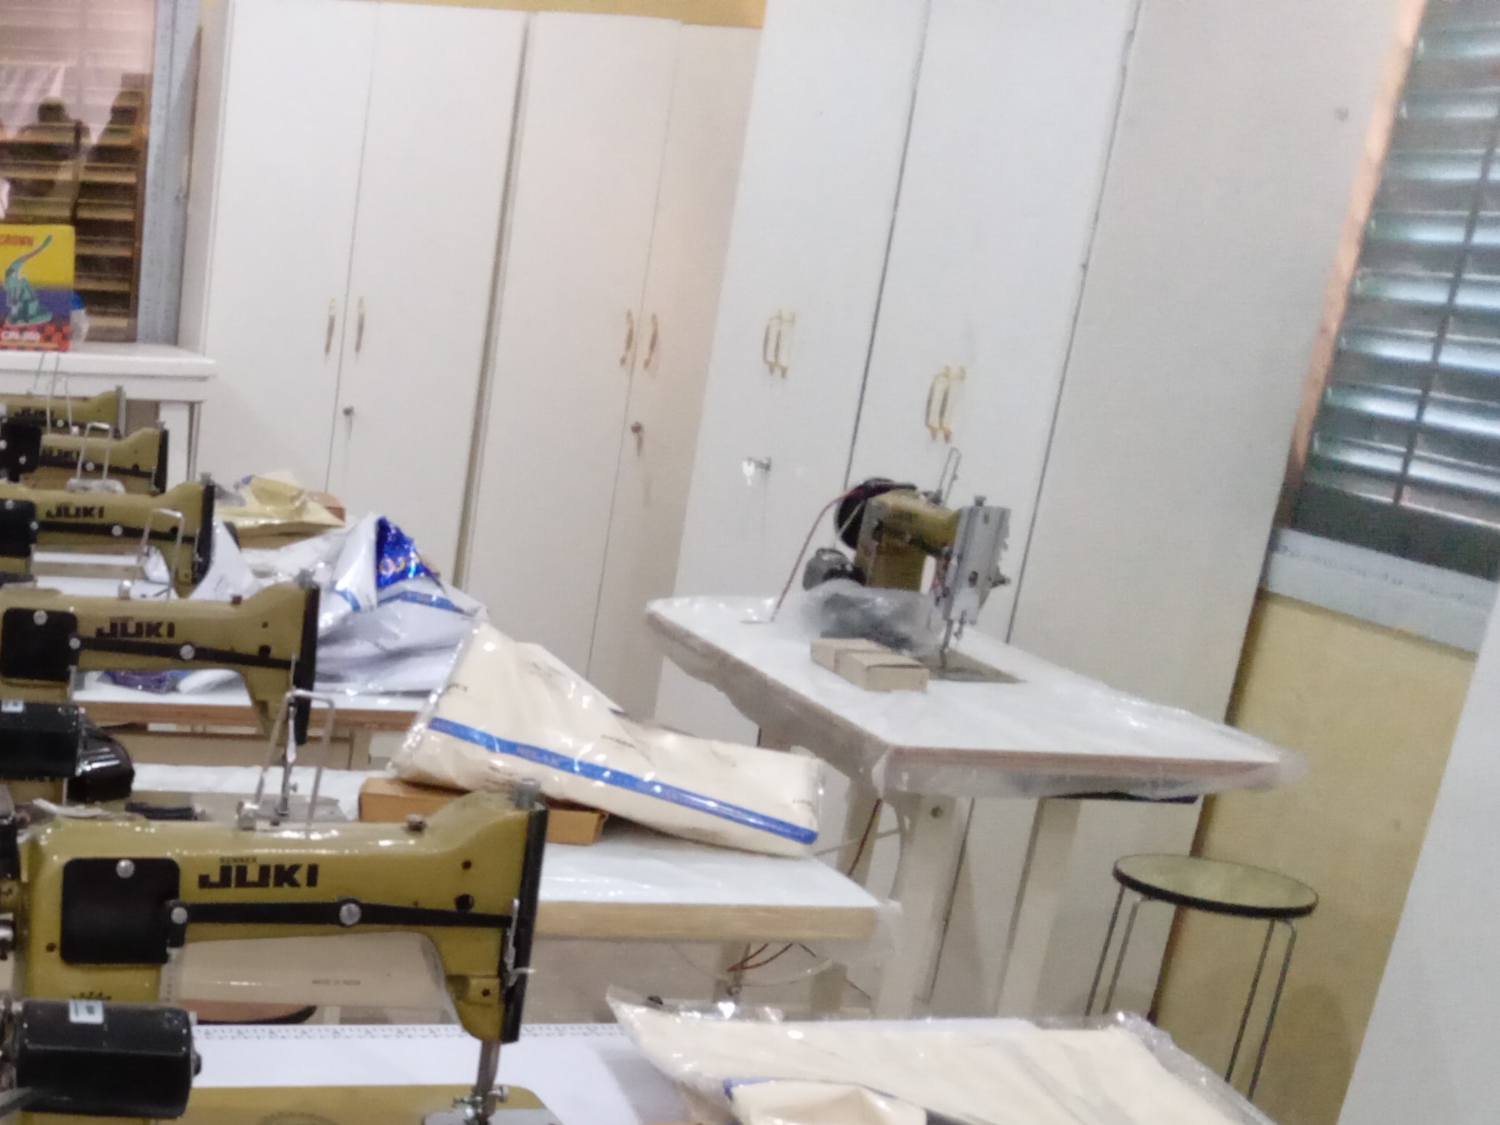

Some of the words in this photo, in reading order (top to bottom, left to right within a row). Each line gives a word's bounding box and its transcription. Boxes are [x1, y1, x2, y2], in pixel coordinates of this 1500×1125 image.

[45, 505, 105, 519] JUKI
[95, 621, 175, 639] JUKI
[197, 863, 319, 888] JUKI
